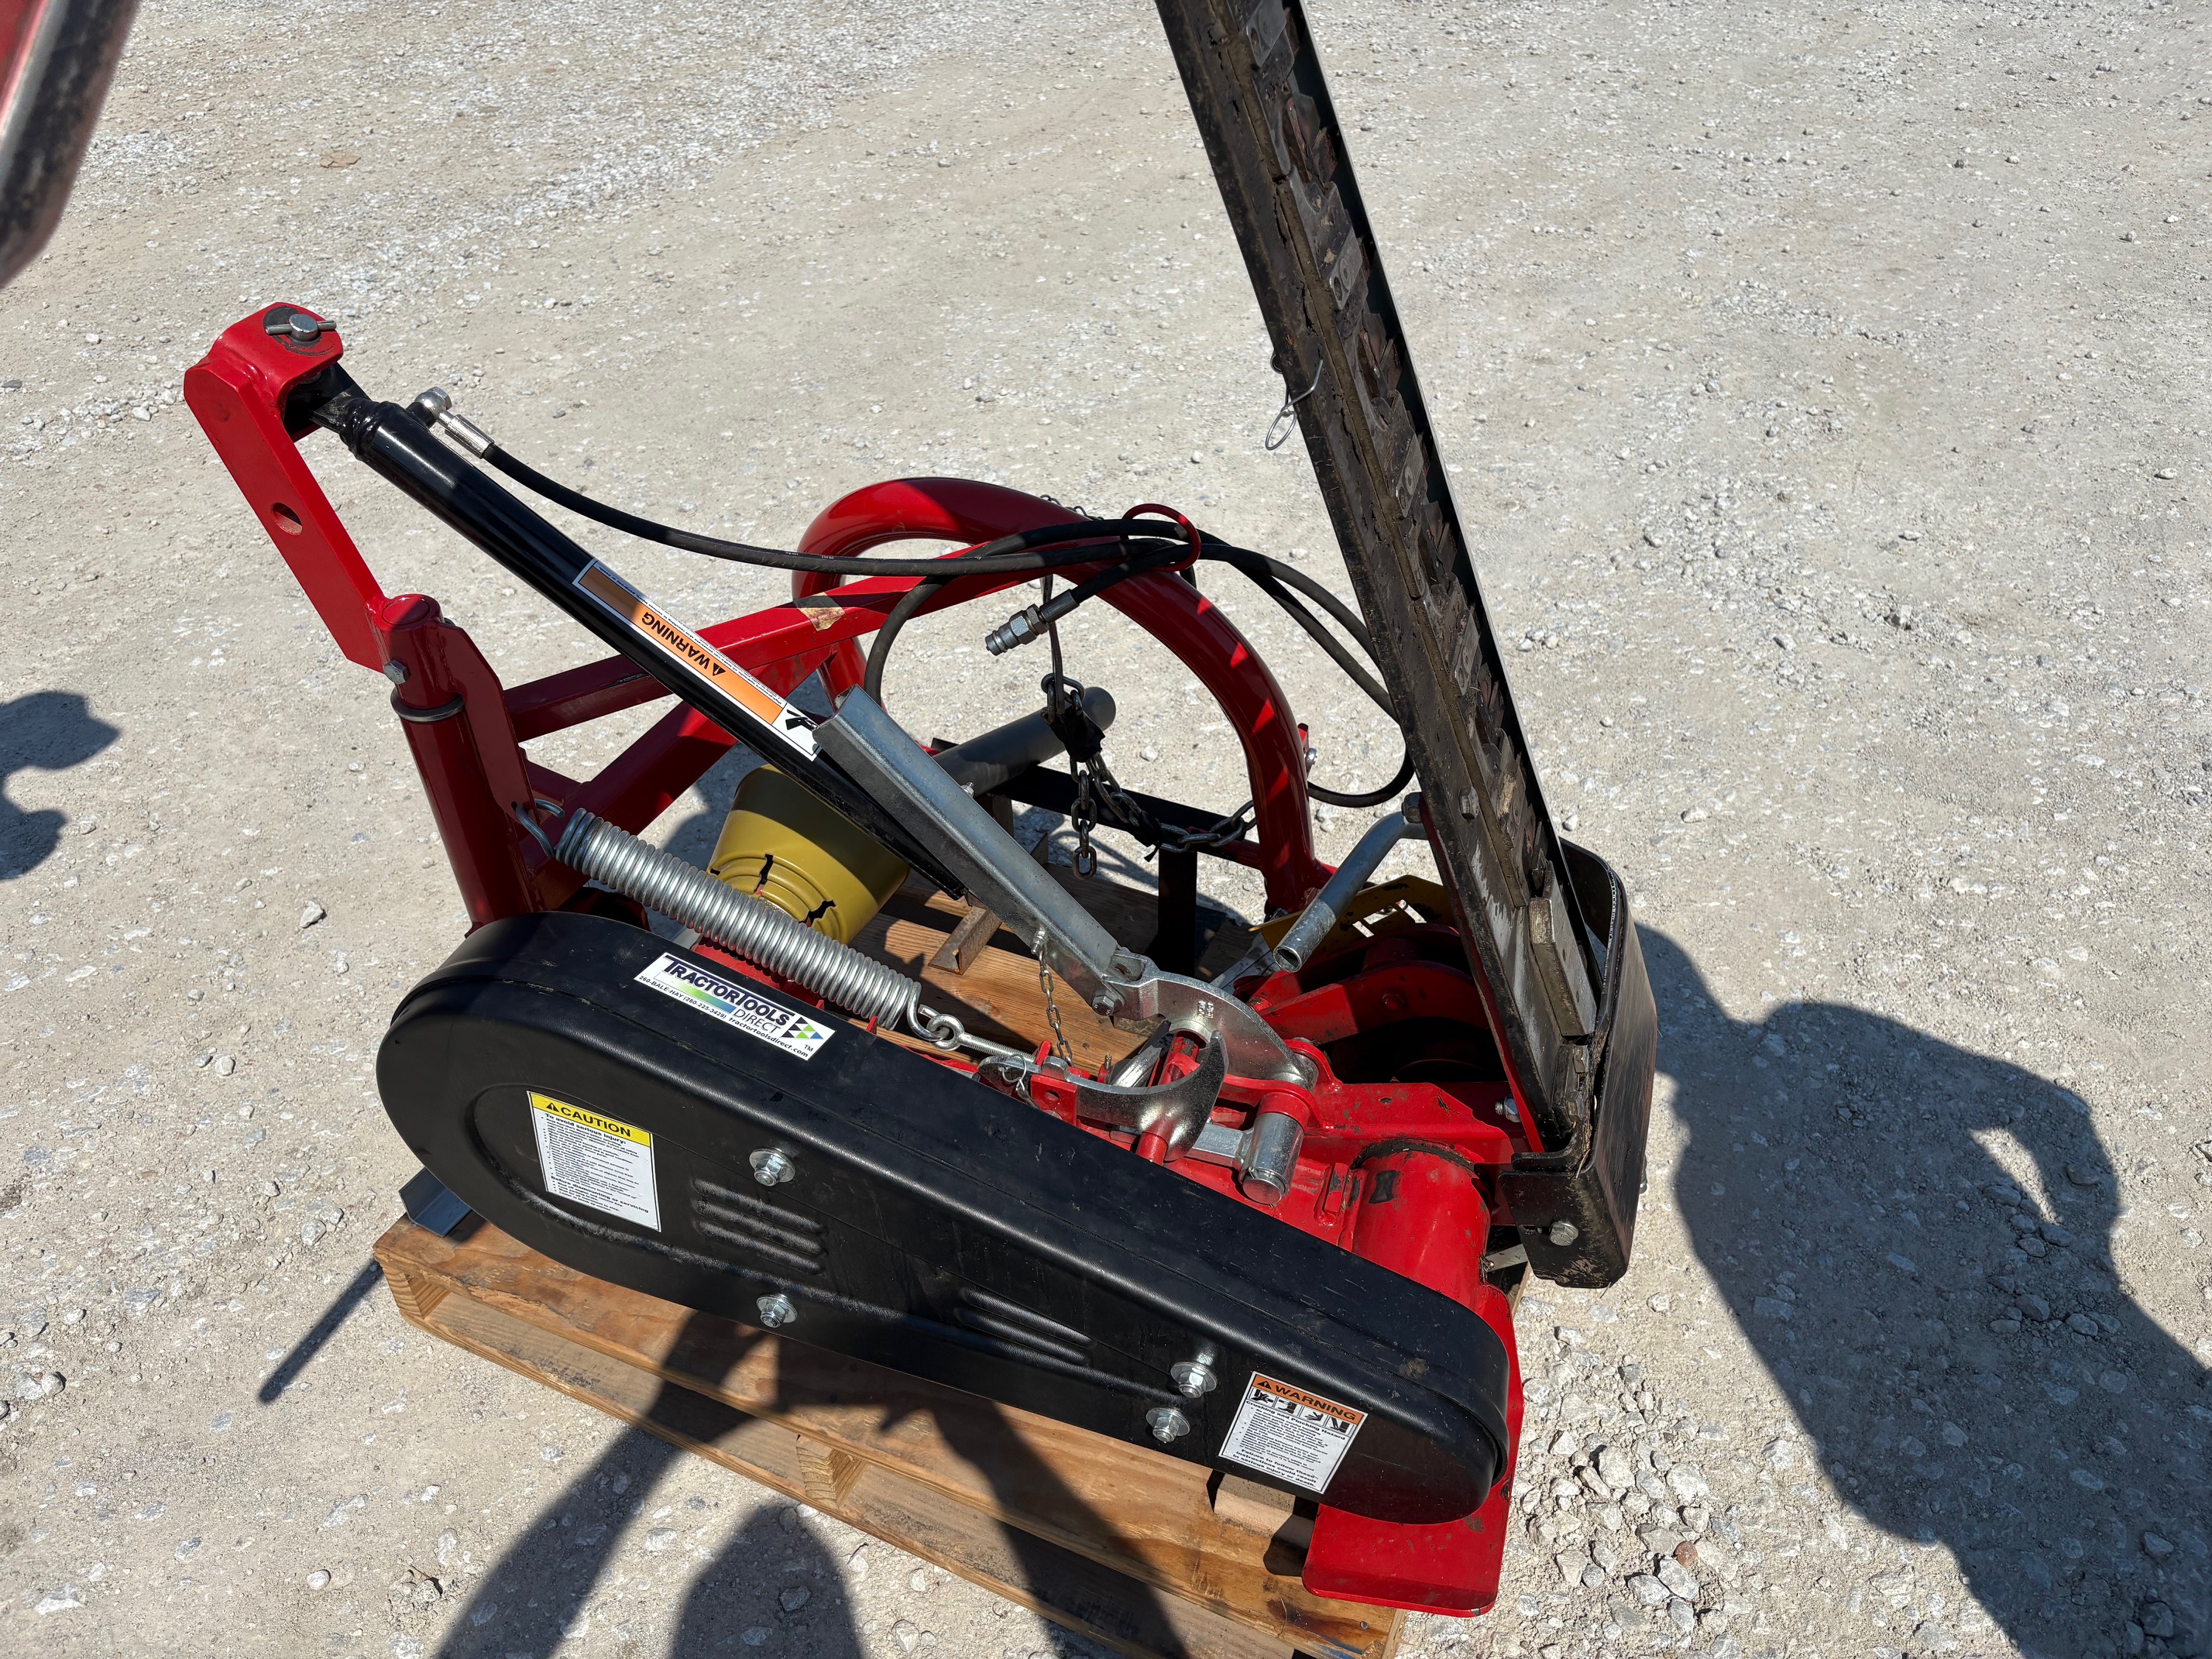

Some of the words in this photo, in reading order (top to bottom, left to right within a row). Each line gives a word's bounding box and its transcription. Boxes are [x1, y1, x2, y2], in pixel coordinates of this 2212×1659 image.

[641, 612, 710, 669] WARNING
[639, 976, 684, 998] 260-BALE-HAY
[729, 1017, 808, 1057] tractortoolsdirect.com
[733, 1009, 781, 1033] DIRECT
[555, 1118, 575, 1126] avoid
[576, 1125, 602, 1136] serious
[603, 1134, 626, 1145] injury:
[561, 1107, 631, 1137] CAUTION
[620, 1200, 649, 1213] servicing
[1276, 1385, 1357, 1420] WARNING
[1246, 1400, 1276, 1414] Crushing
[1276, 1412, 1290, 1421] and
[1291, 1417, 1320, 1431] Pinching
[1321, 1430, 1345, 1441] Hazard
